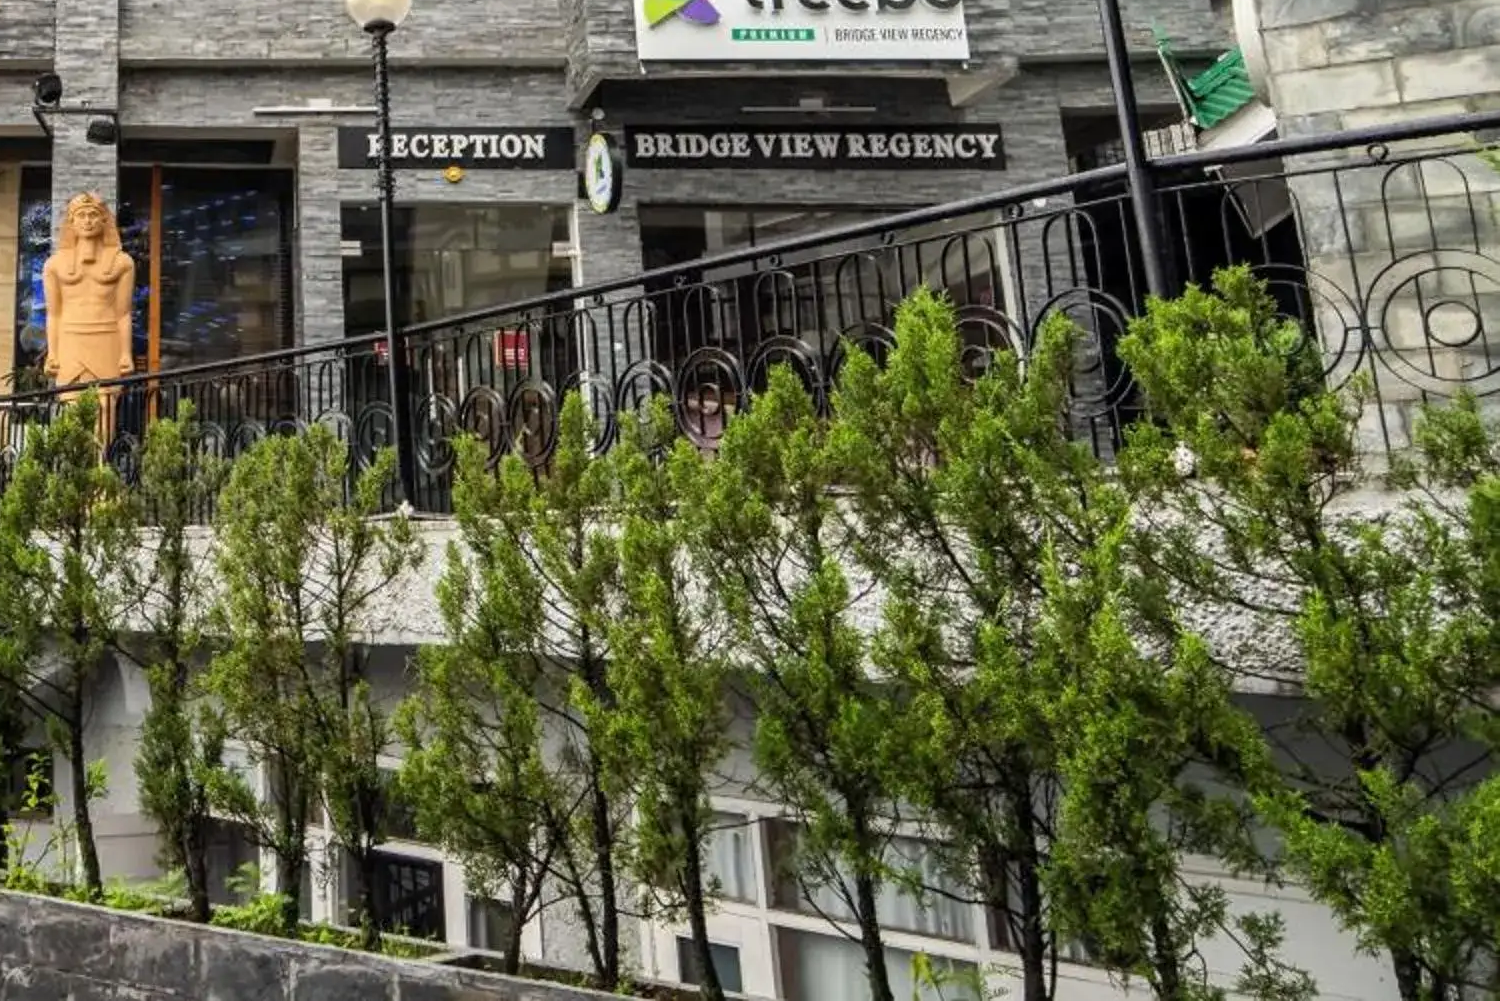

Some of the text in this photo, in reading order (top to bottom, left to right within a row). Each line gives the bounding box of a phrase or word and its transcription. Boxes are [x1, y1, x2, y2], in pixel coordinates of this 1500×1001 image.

[835, 28, 878, 41] BRIDGE
[881, 28, 908, 40] VIEW
[911, 28, 963, 40] REGENCY
[635, 133, 999, 159] BRIDGE VIEW REGENCY
